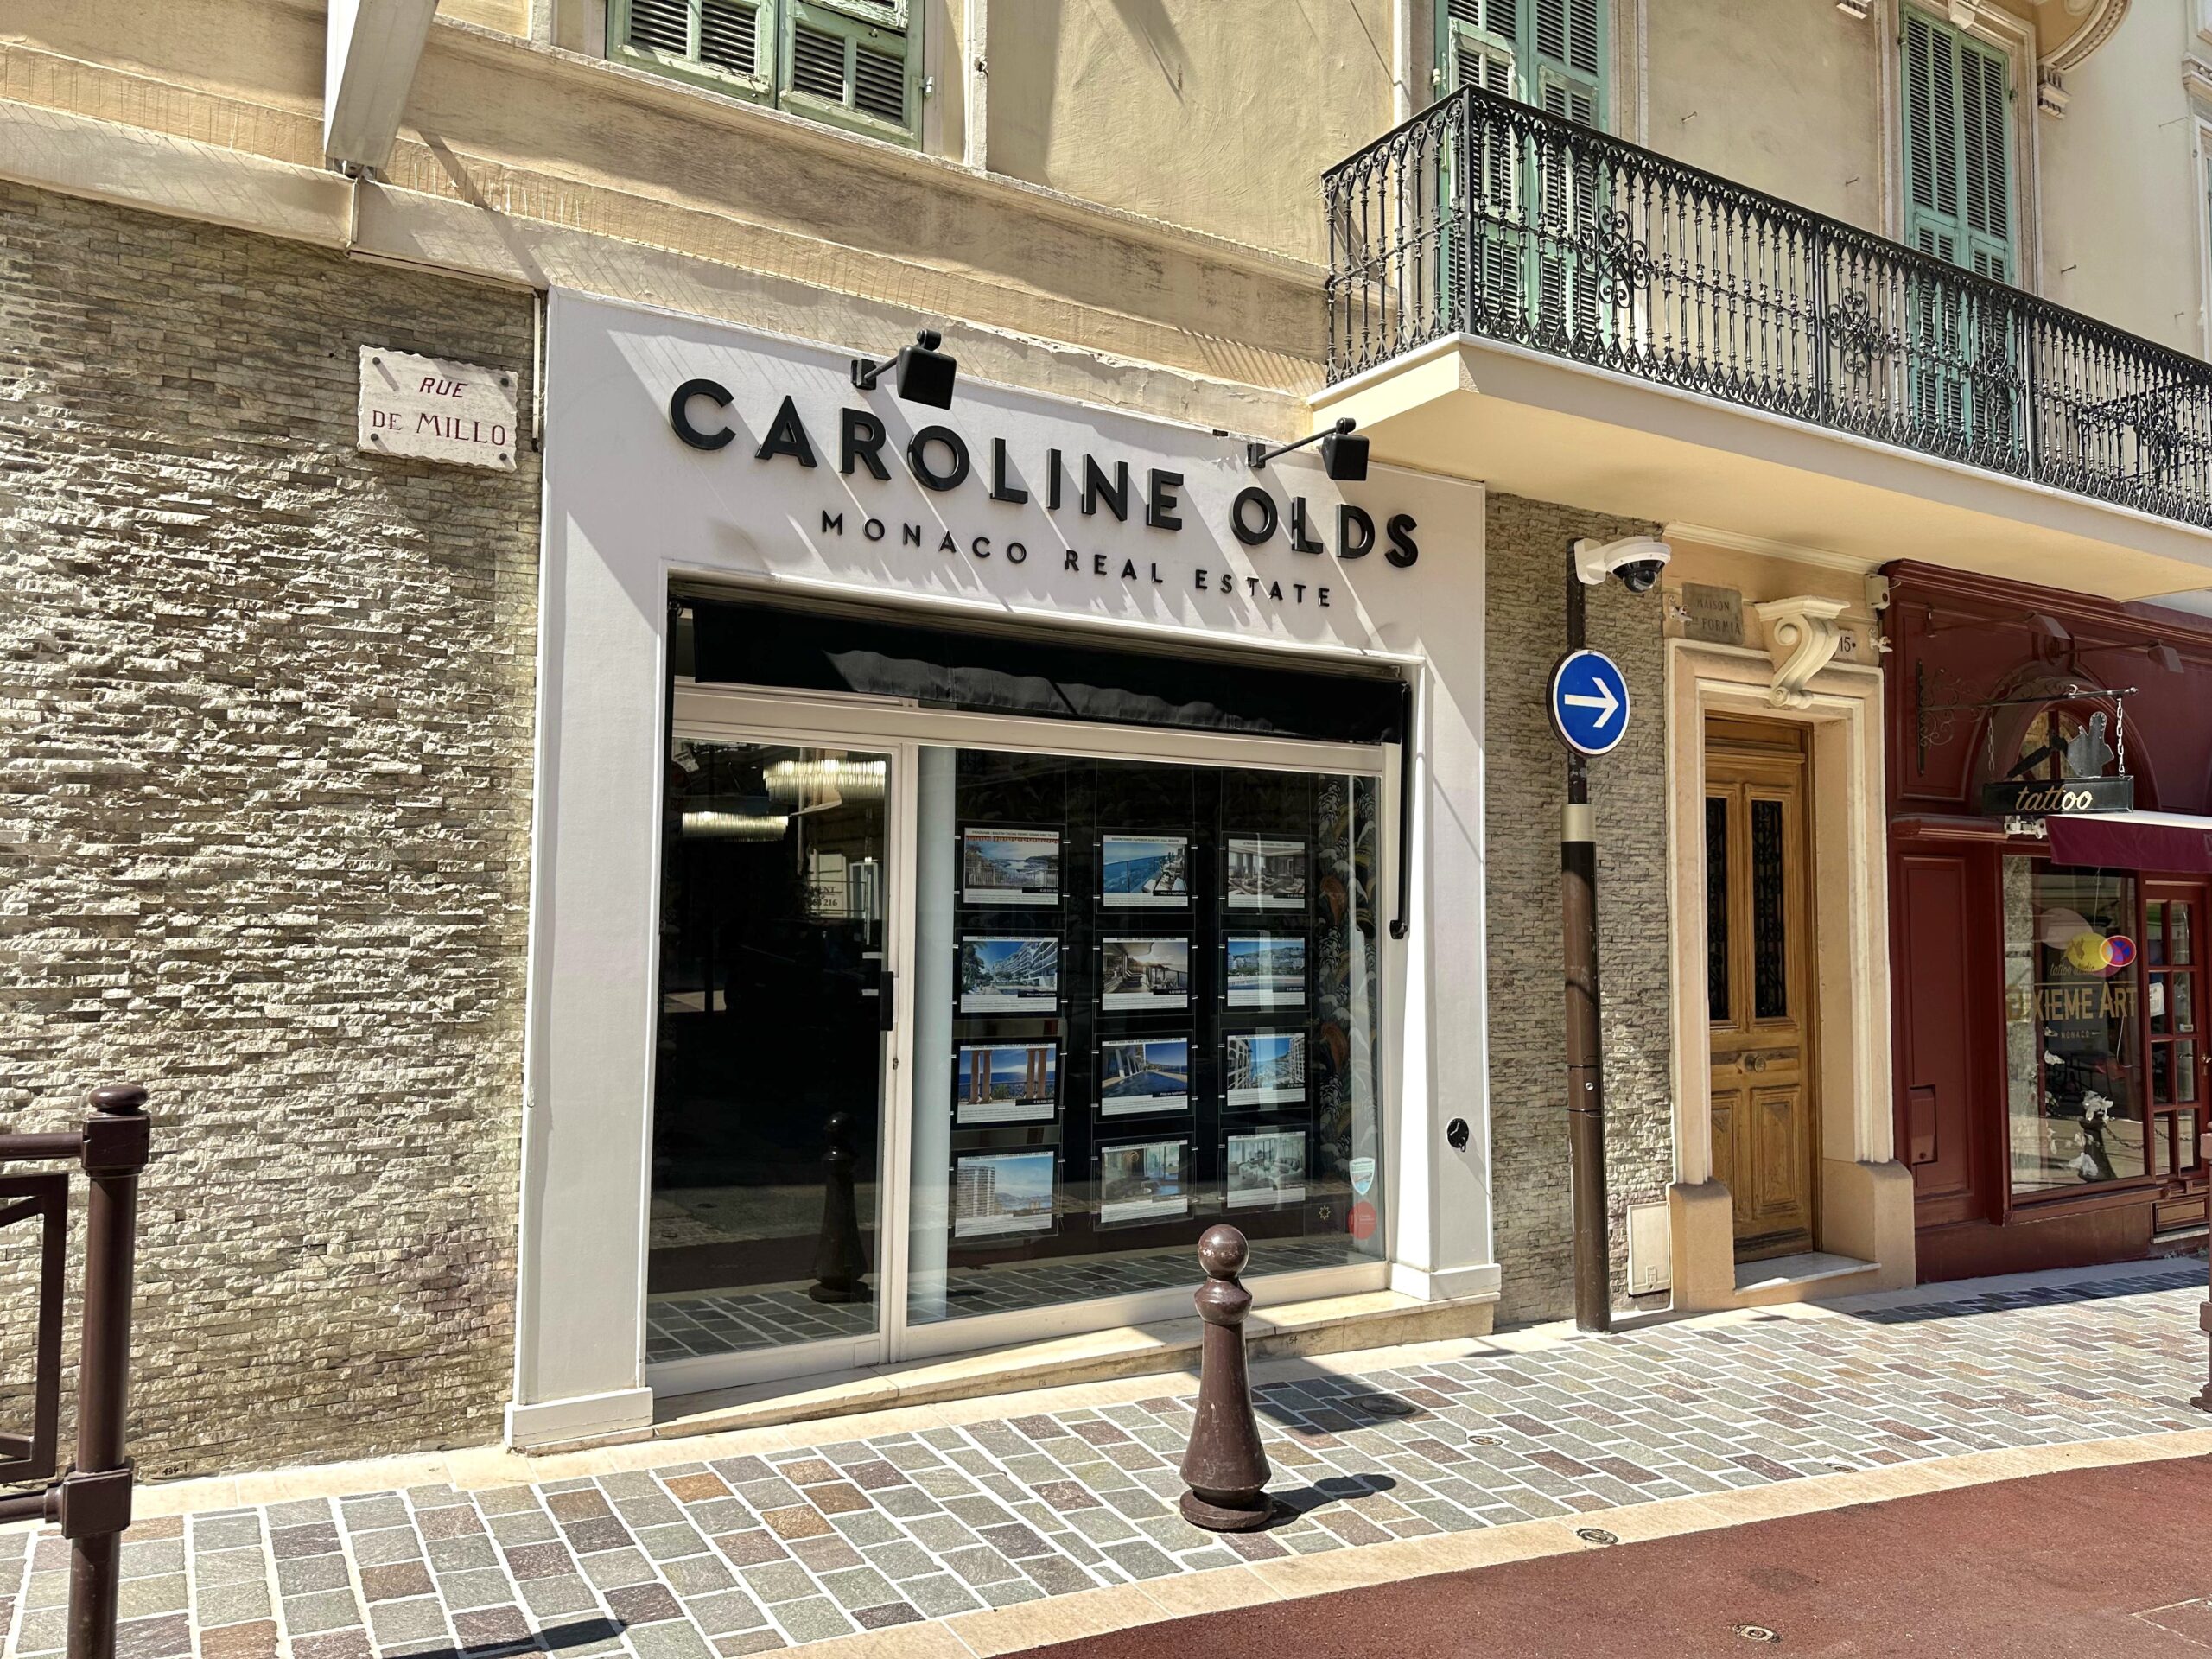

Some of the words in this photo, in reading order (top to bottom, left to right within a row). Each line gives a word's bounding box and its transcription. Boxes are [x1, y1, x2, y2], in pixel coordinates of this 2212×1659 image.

[419, 377, 468, 398] RUE
[372, 410, 402, 430] DE
[415, 412, 505, 446] MILLO
[670, 378, 1184, 531] CAROLINE
[1228, 486, 1419, 568] OLDS
[822, 510, 1027, 564] MONACO
[1064, 549, 1163, 583] REAL
[1195, 569, 1330, 607] ESTATE
[1696, 597, 1730, 611] MAISON
[2015, 785, 2093, 811] tattoo
[2099, 982, 2137, 1019] ART
